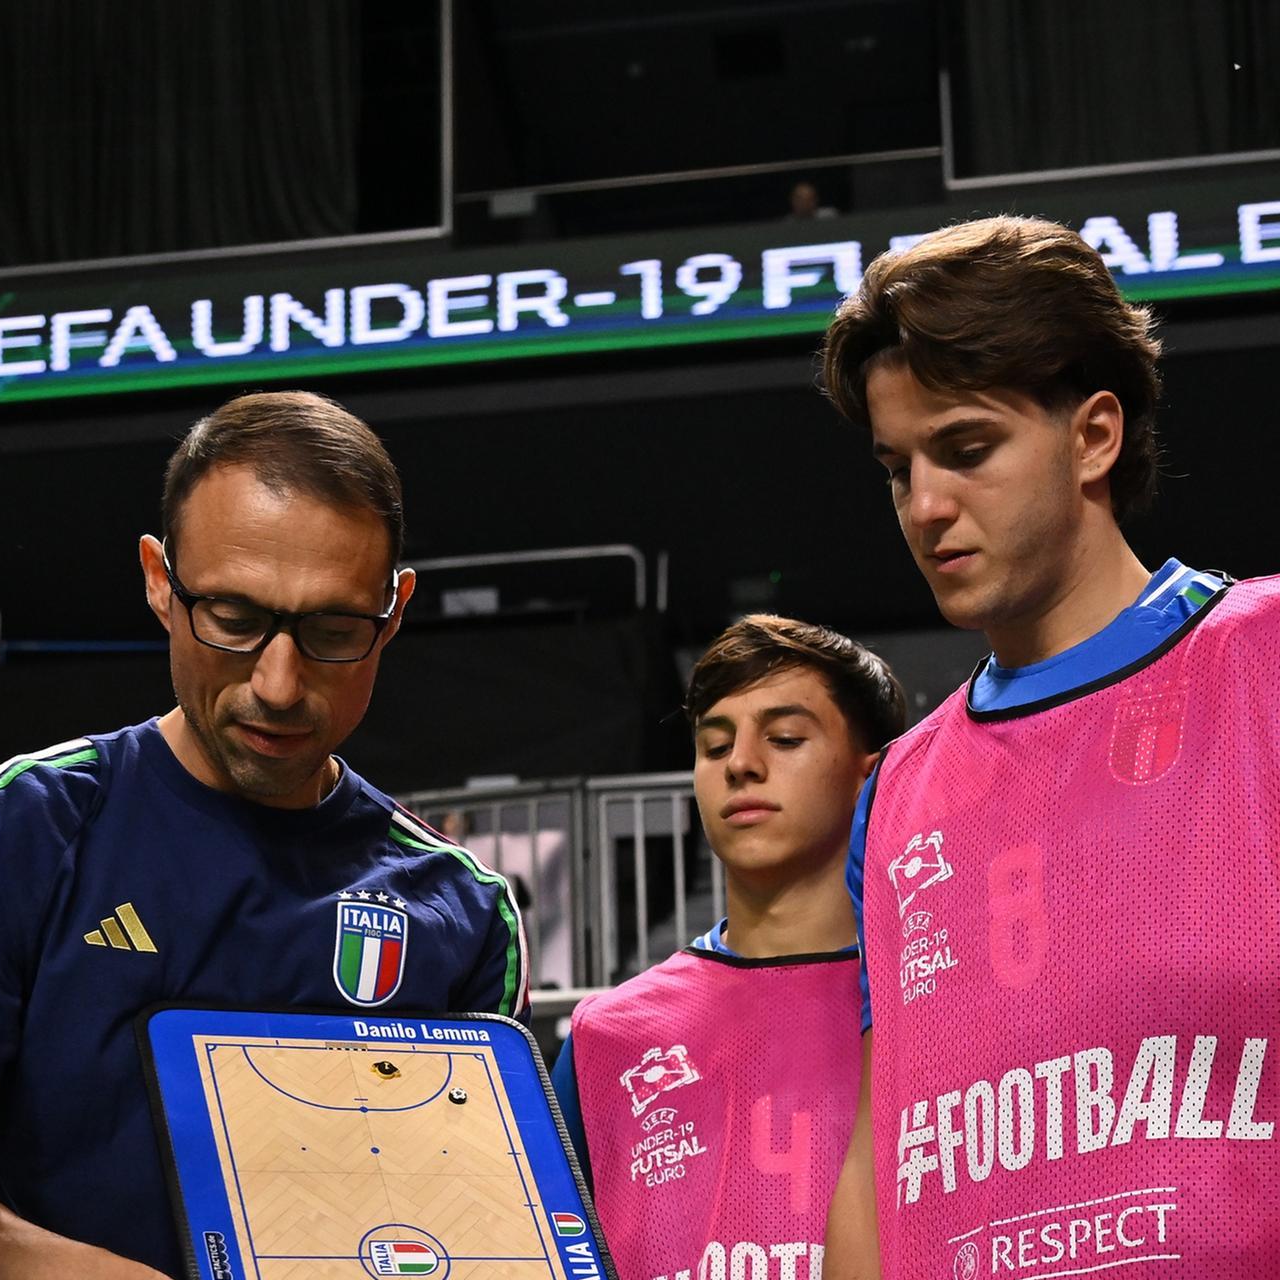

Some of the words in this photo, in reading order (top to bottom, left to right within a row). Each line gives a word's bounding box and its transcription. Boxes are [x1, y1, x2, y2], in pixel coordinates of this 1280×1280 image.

[191, 252, 743, 359] UNDER-19
[343, 907, 403, 934] ITALIA
[899, 946, 959, 989] UTSAL
[353, 1020, 417, 1039] Danilo
[420, 1023, 491, 1042] Lemma
[641, 1109, 676, 1132] UEFA
[895, 1034, 1275, 1211] #FOOTBALL
[630, 1121, 695, 1158] UNDER-19
[629, 1136, 708, 1182] FUTSAL
[645, 1164, 686, 1187] EURO
[990, 1203, 1177, 1273] RESPECT
[374, 1243, 393, 1273] ITALIA
